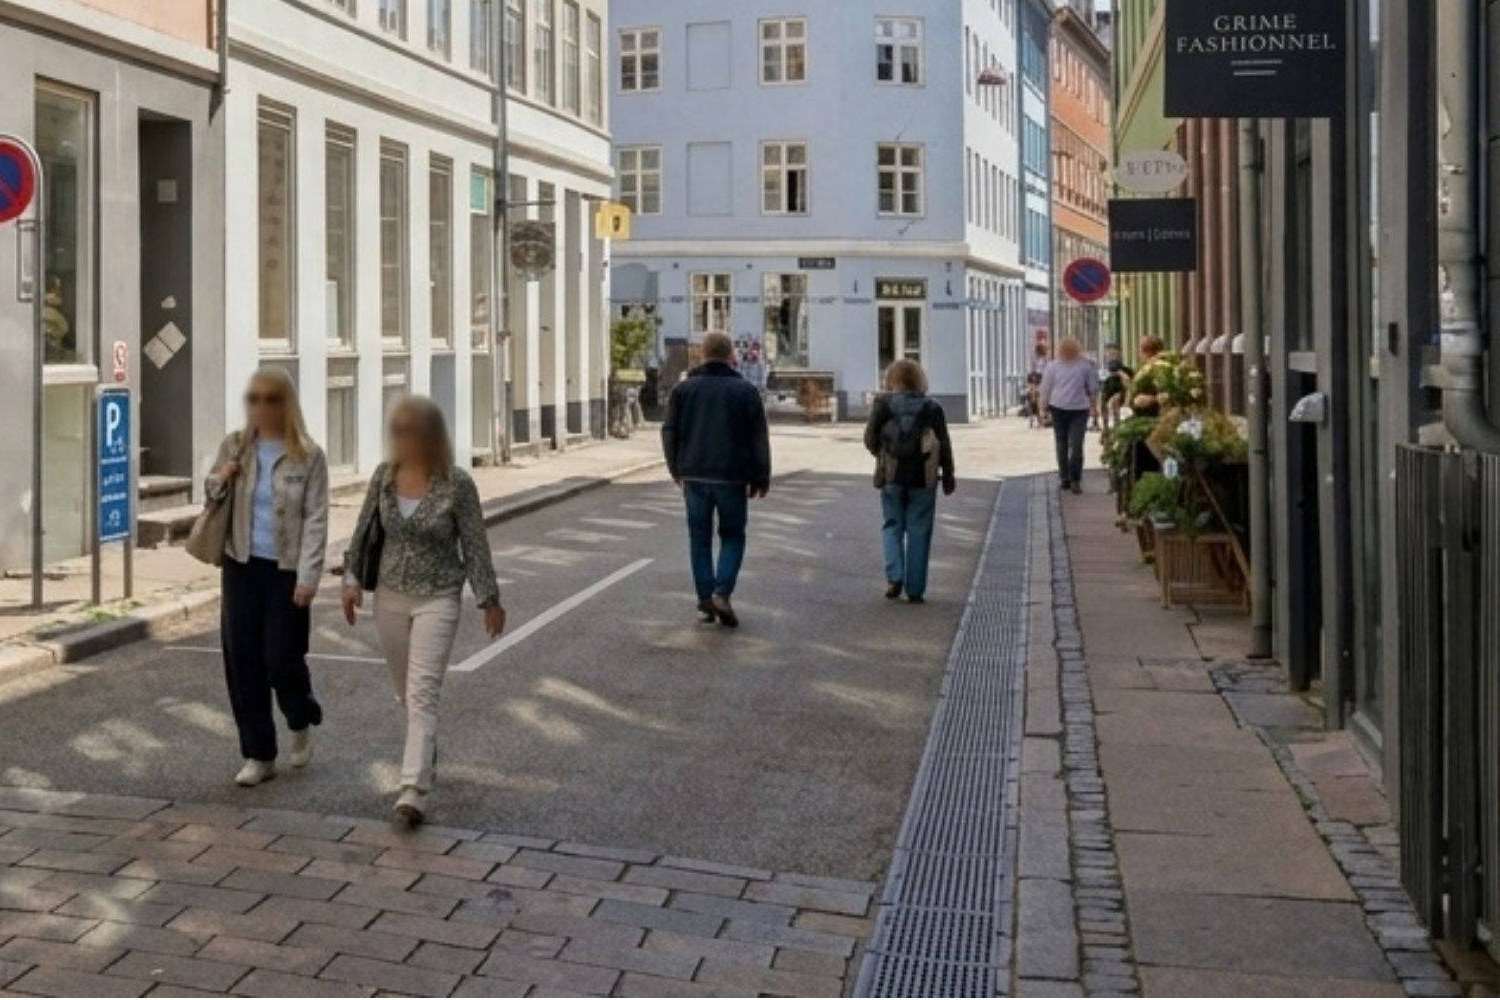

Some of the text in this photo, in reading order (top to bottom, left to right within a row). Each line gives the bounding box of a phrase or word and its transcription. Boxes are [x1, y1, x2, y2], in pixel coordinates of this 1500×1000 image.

[1213, 13, 1297, 32] GRIME
[1176, 33, 1336, 53] FASHIONNEL
[106, 402, 120, 447] P
